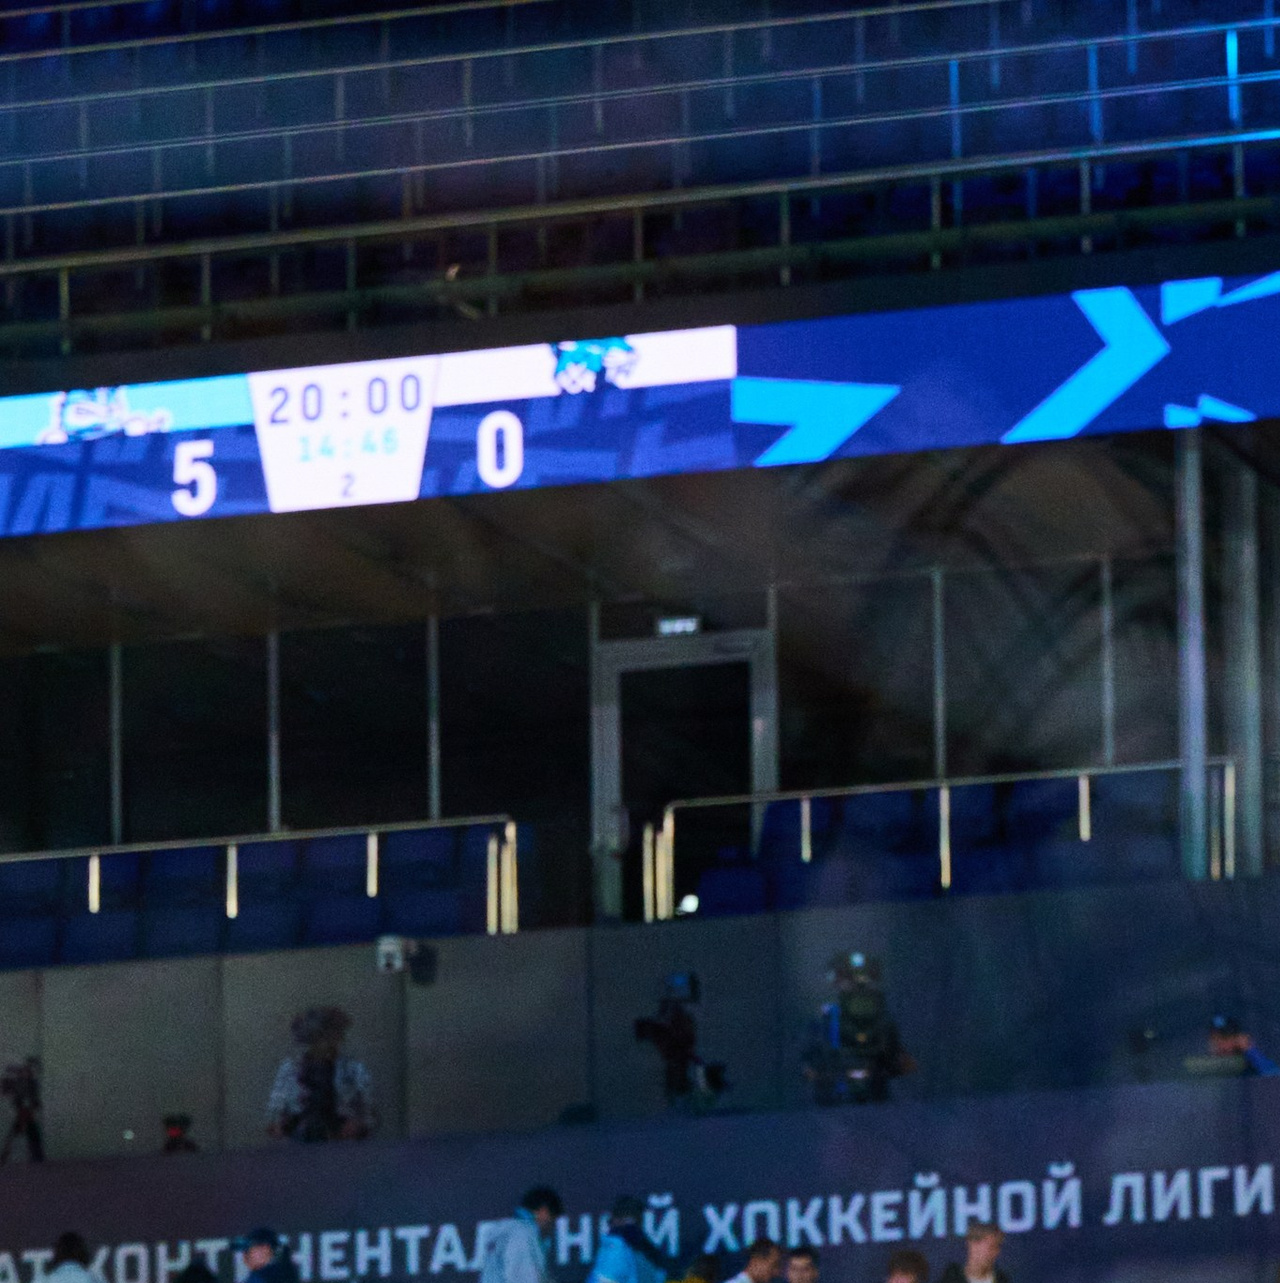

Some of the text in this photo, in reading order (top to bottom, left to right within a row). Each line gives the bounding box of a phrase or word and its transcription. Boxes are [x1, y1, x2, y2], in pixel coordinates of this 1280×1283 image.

[269, 373, 421, 425] 20:00
[170, 440, 217, 517] 5
[477, 410, 523, 488] 0
[1103, 1163, 1275, 1227] ЛИГИ
